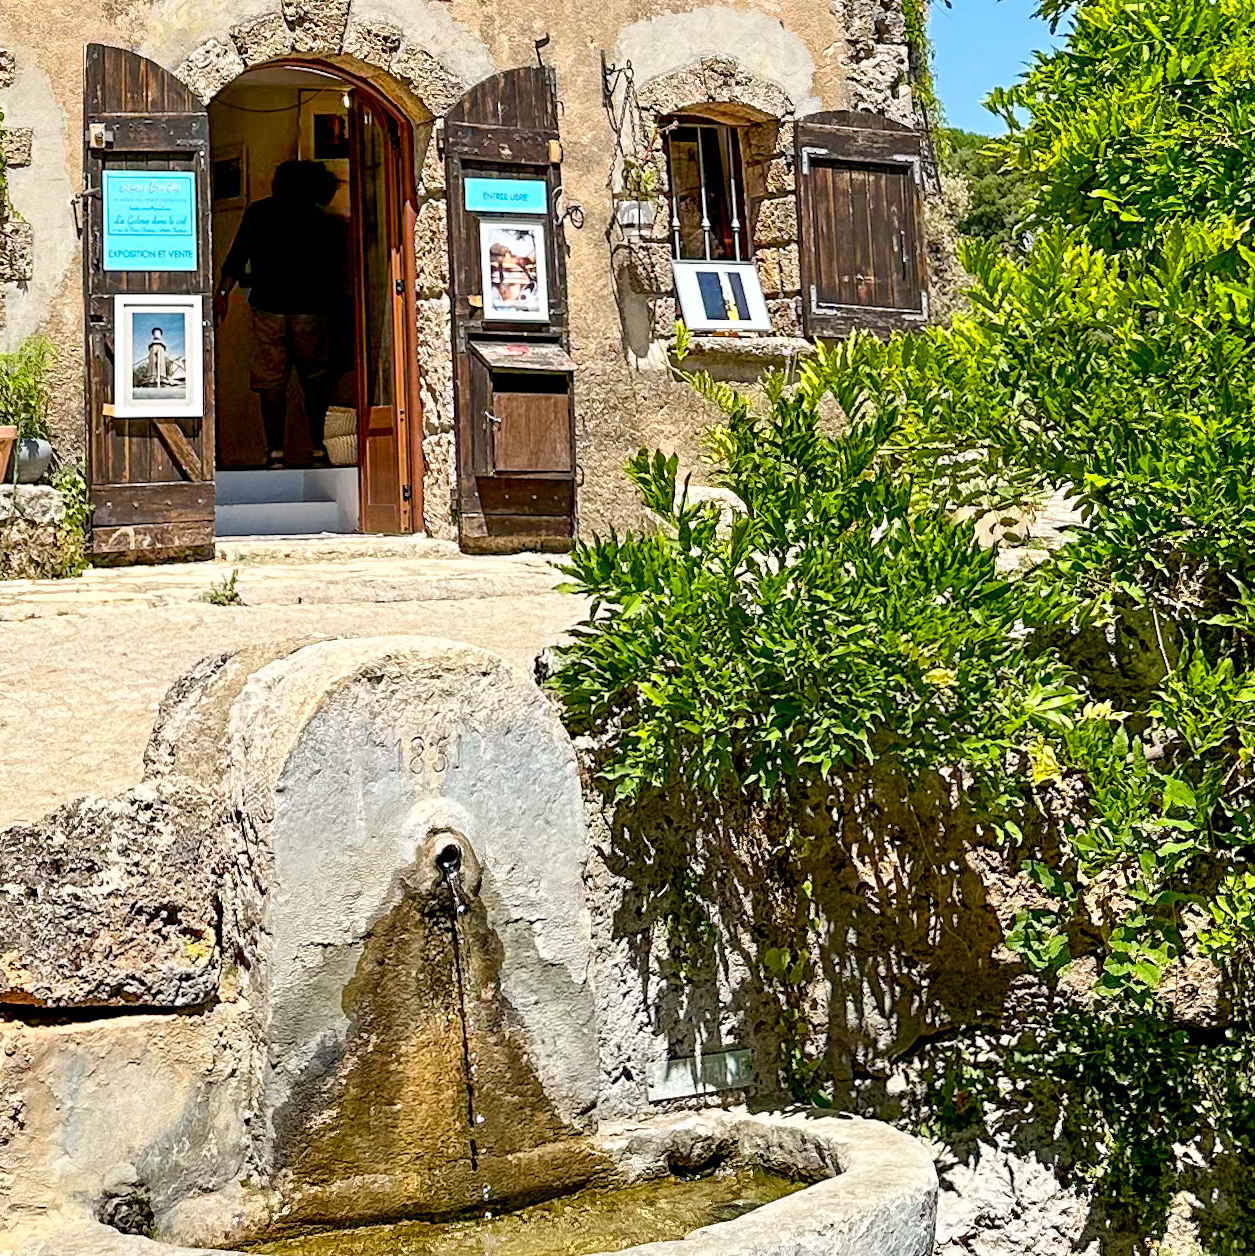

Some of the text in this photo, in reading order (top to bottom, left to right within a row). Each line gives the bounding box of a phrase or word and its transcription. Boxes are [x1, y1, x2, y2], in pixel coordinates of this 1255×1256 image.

[108, 249, 193, 258] EXPOSITION ET VENTE
[389, 734, 462, 774] 1851
